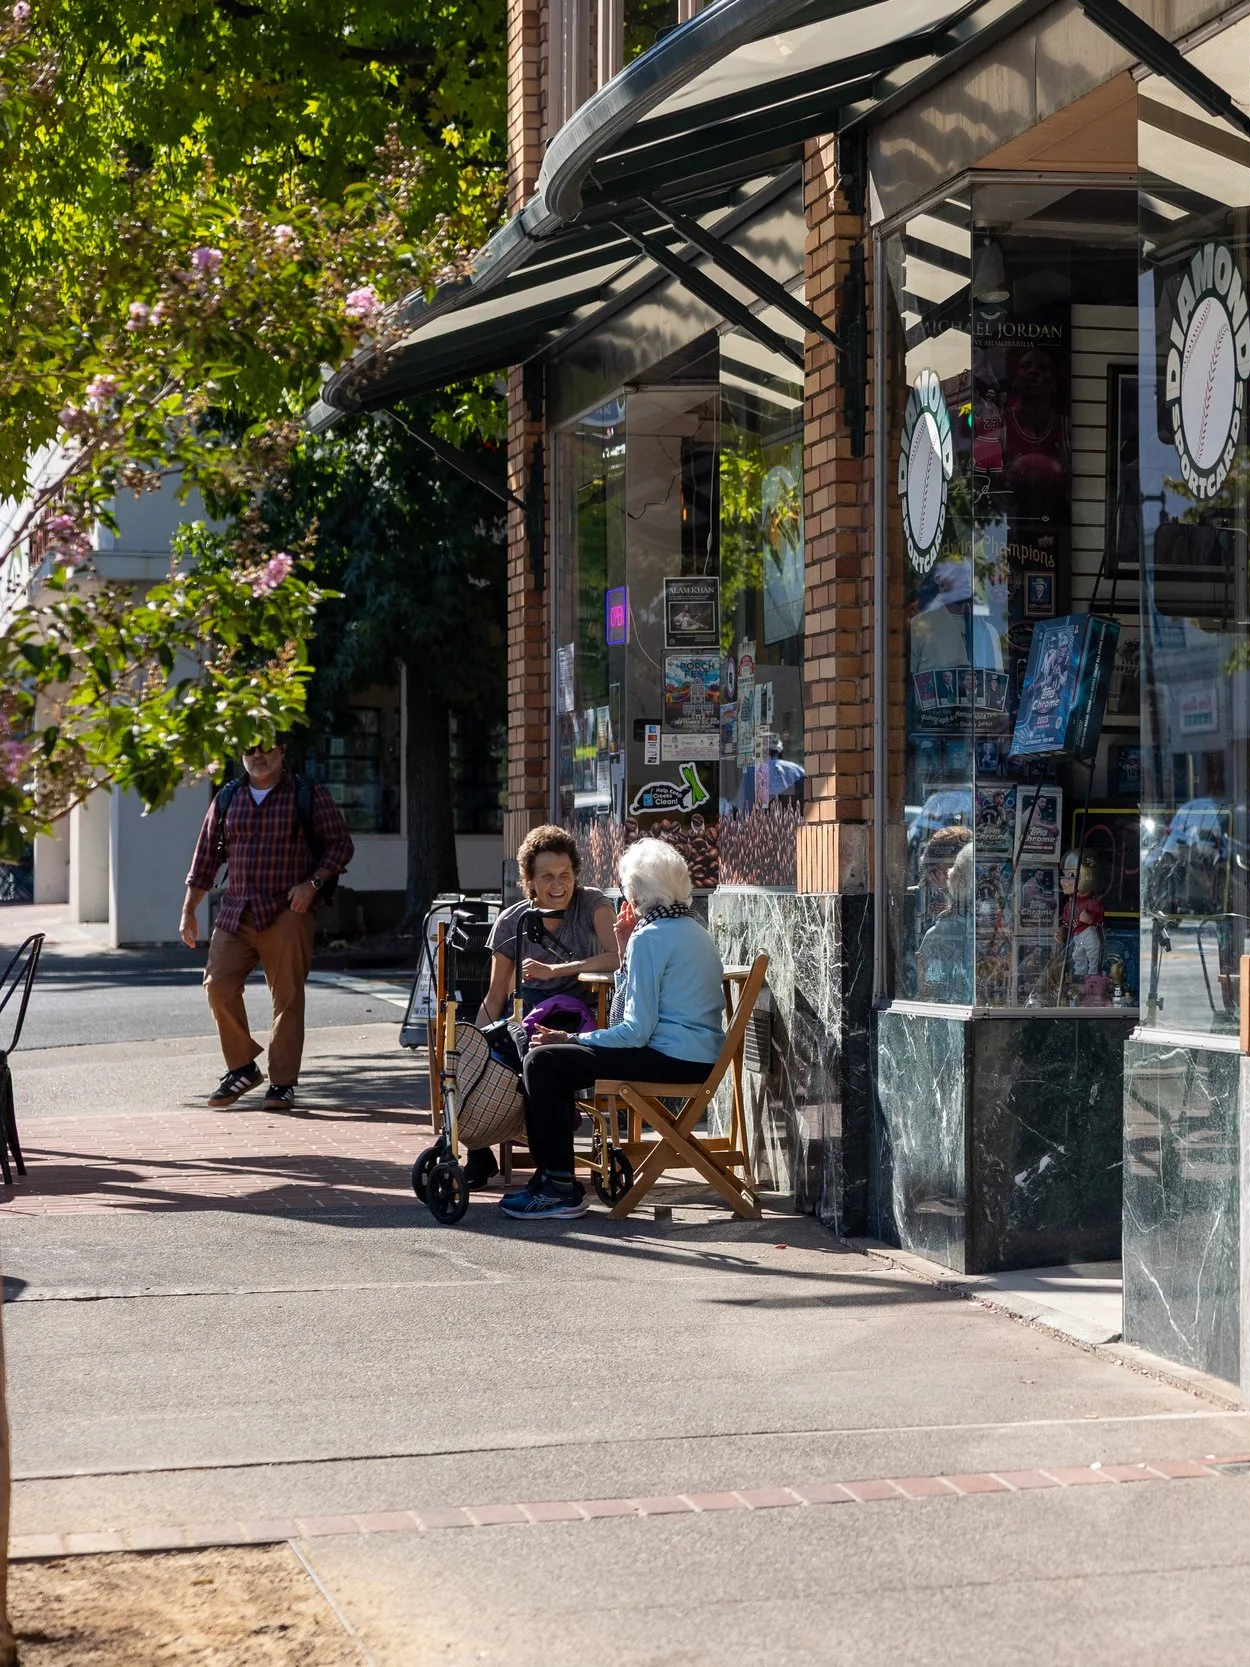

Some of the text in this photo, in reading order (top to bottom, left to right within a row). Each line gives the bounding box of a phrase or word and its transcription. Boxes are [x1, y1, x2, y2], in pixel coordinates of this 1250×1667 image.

[998, 322, 1063, 340] JORDAN
[984, 417, 997, 430] 23
[898, 370, 953, 495] DIAMOND
[975, 535, 1055, 568] Champions
[610, 605, 624, 627] OPEN
[680, 661, 715, 671] PORCH
[684, 670, 709, 678] FEST
[1032, 699, 1060, 710] Chrome
[669, 788, 682, 798] Keep
